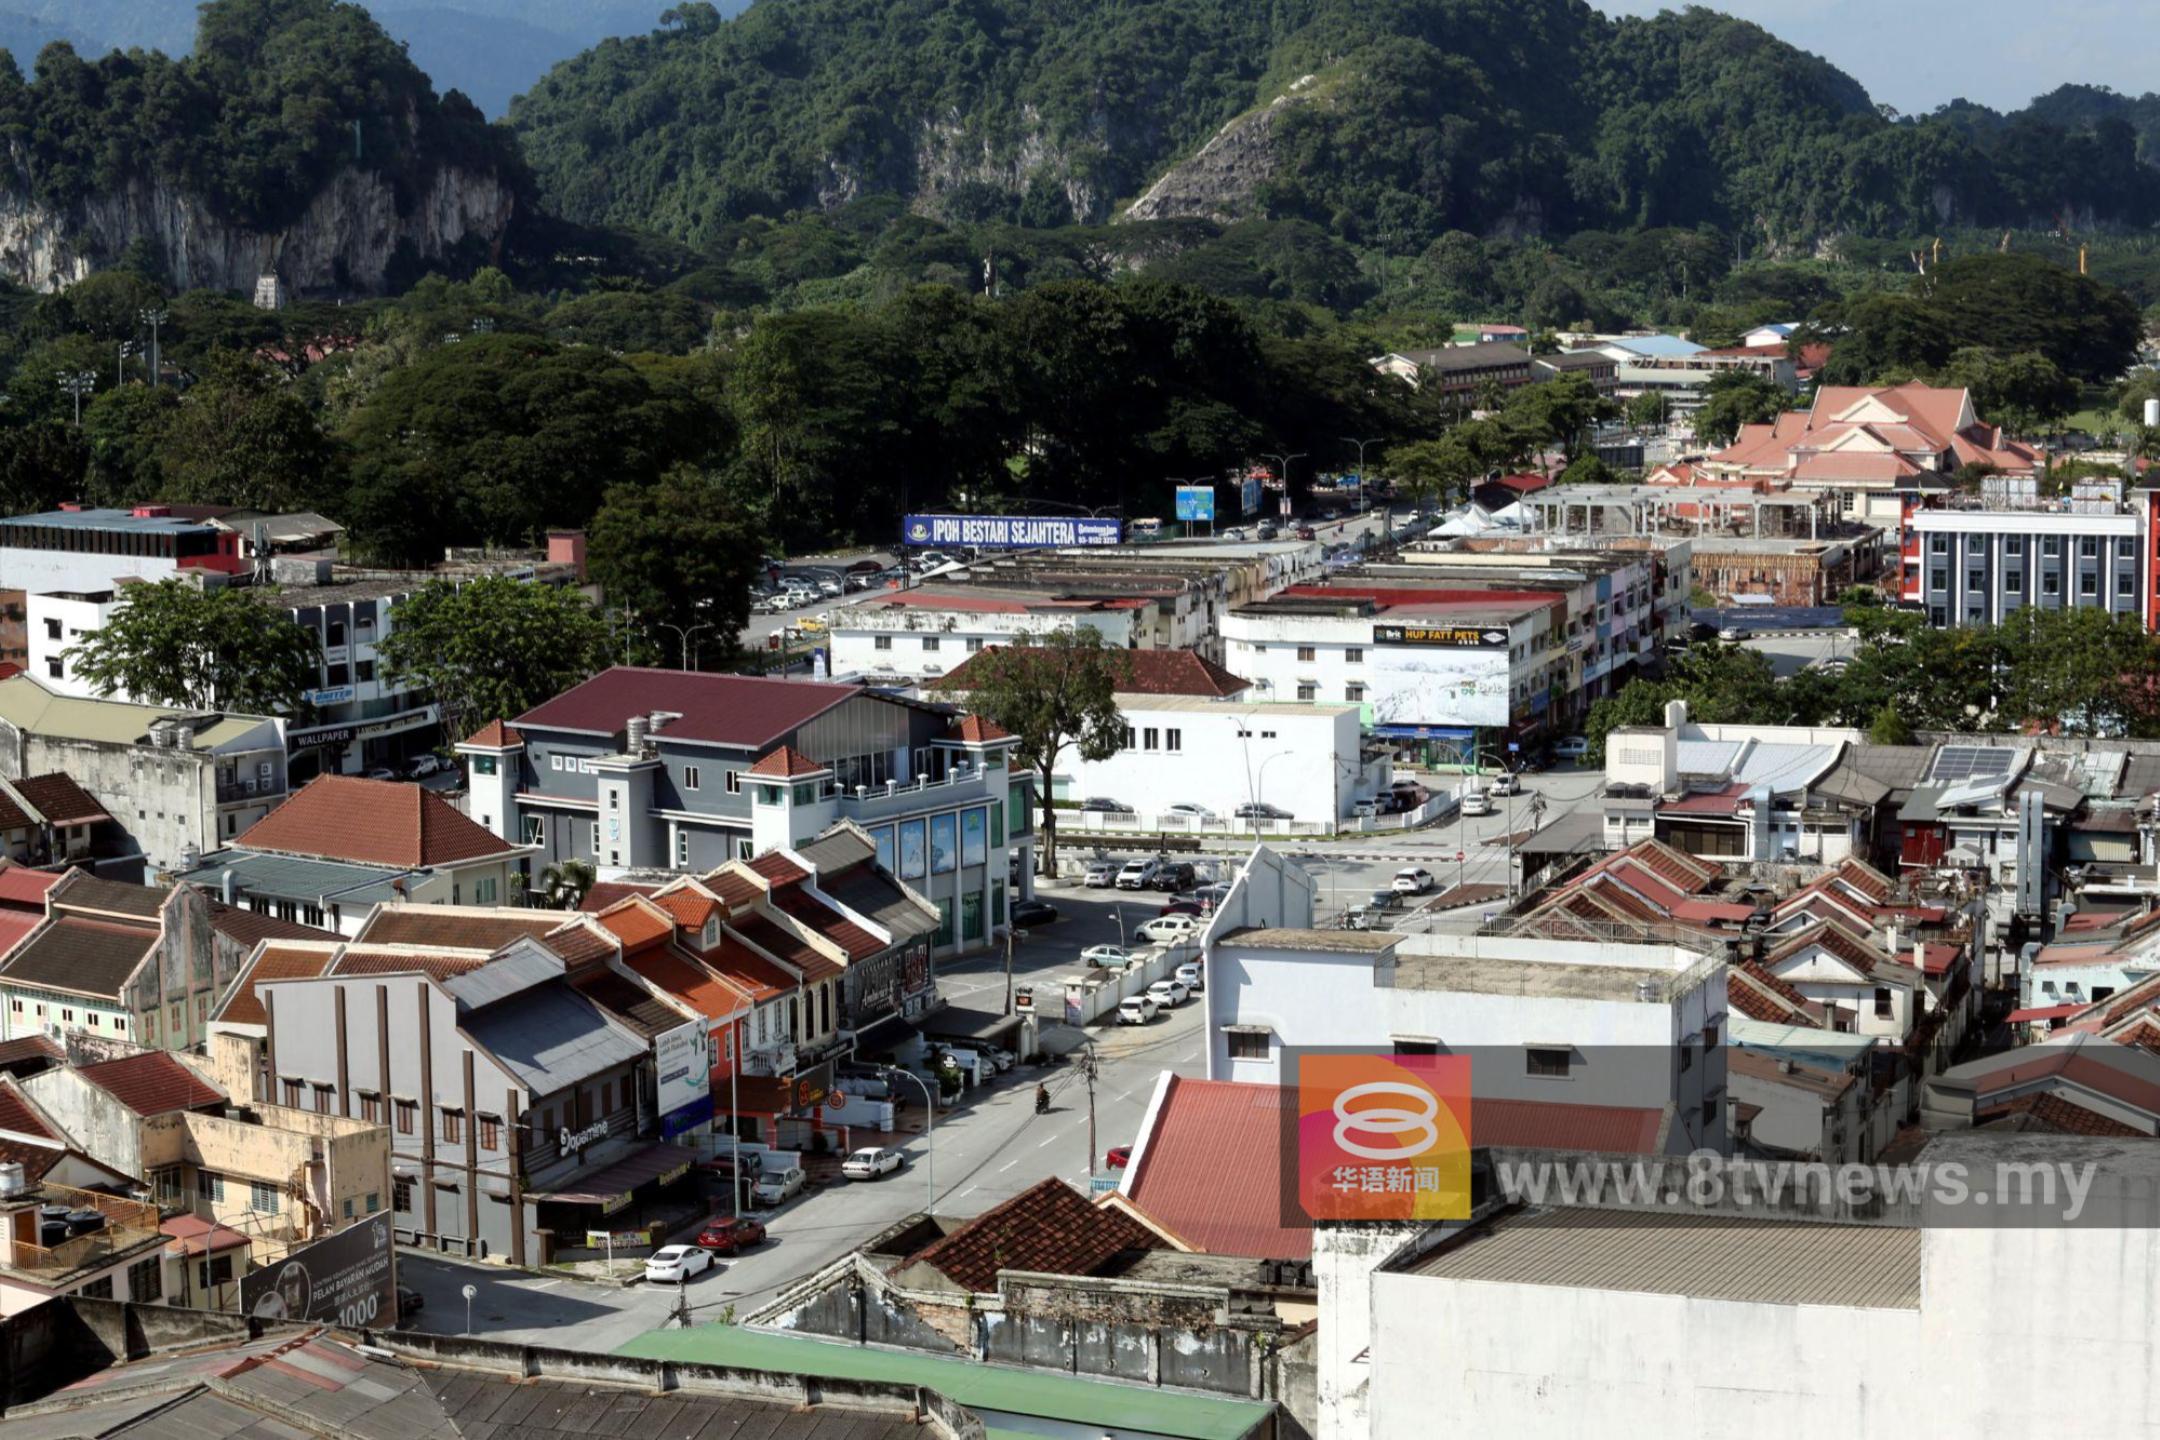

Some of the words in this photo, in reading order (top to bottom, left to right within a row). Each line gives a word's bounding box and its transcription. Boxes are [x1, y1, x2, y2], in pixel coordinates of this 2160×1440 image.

[933, 519, 959, 542] IPOH
[962, 520, 1008, 543] BESTARI
[1011, 521, 1075, 545] SEJAHTERA
[1386, 630, 1401, 640] Brit
[1405, 630, 1425, 640] HUP
[1428, 630, 1452, 640] FATT
[1454, 631, 1479, 640] PETS
[298, 729, 349, 746] WALLPAPER
[560, 1120, 608, 1157] Dopamine
[312, 1284, 335, 1302] PELAN
[335, 1267, 364, 1291] BAYARAN
[365, 1256, 389, 1277] MUDAH
